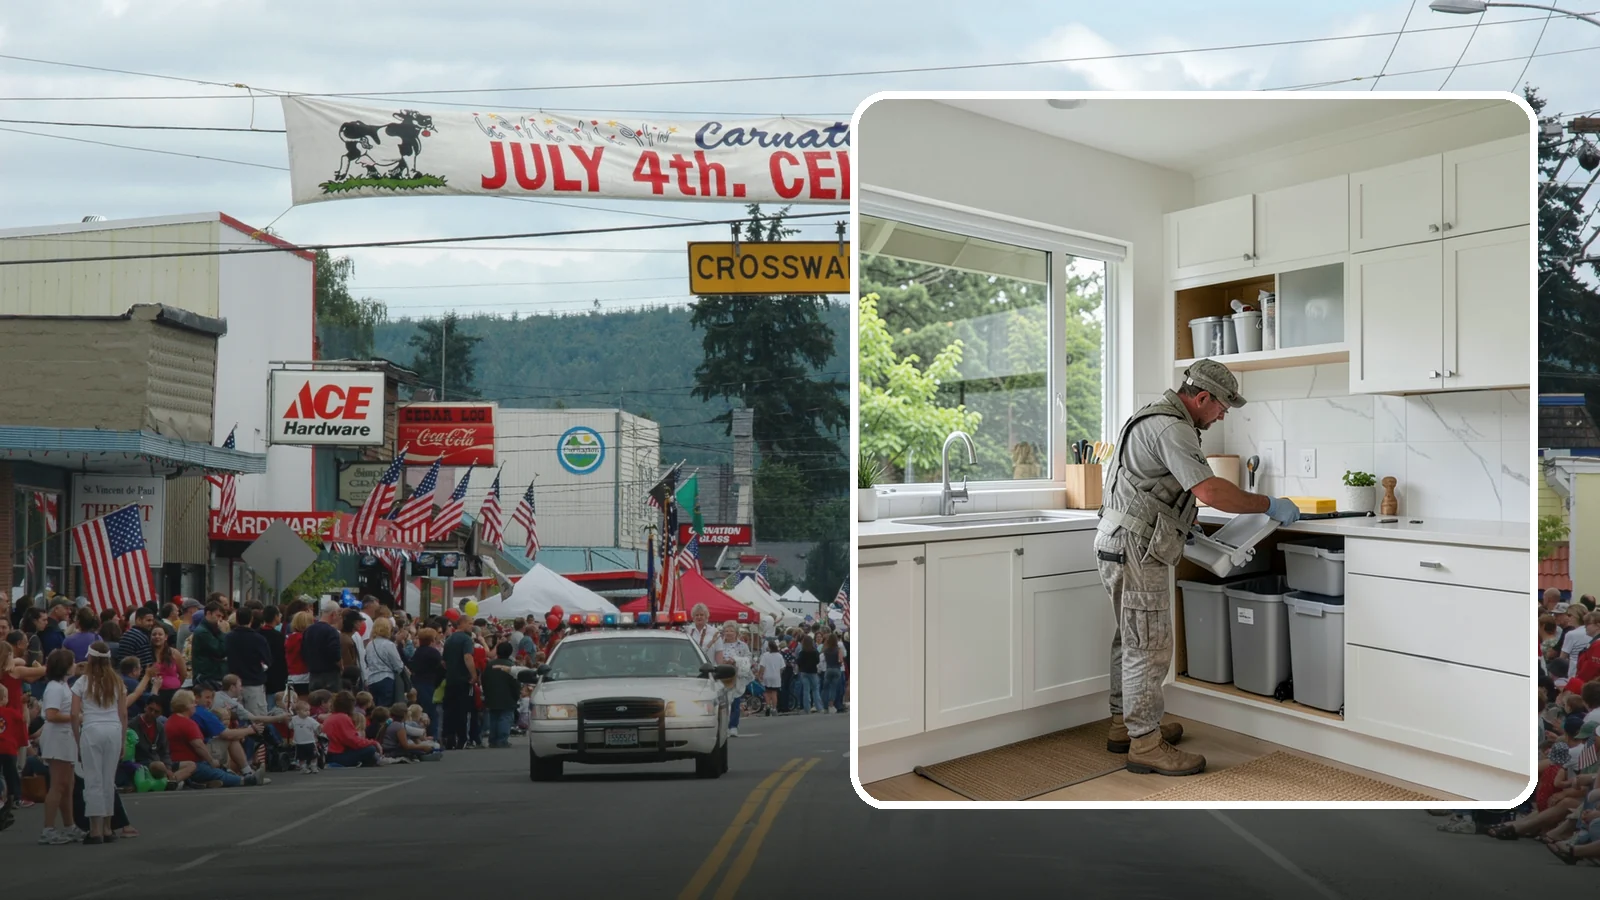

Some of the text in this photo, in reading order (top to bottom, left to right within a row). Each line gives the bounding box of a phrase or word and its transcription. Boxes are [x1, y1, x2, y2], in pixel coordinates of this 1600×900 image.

[481, 141, 605, 193] JULY
[632, 150, 746, 198] 4th.
[697, 254, 850, 280] CROSSWA
[283, 380, 373, 420] ACE
[406, 409, 453, 421] CEDAR
[283, 421, 371, 437] Hardware
[416, 428, 476, 447] Coca-Cola
[354, 467, 385, 479] Simpl
[96, 485, 125, 494] Vincent
[126, 486, 136, 494] de
[138, 486, 155, 495] Paul
[81, 502, 154, 522] THT
[688, 526, 741, 535] CRNATION
[699, 535, 730, 543] GLASS
